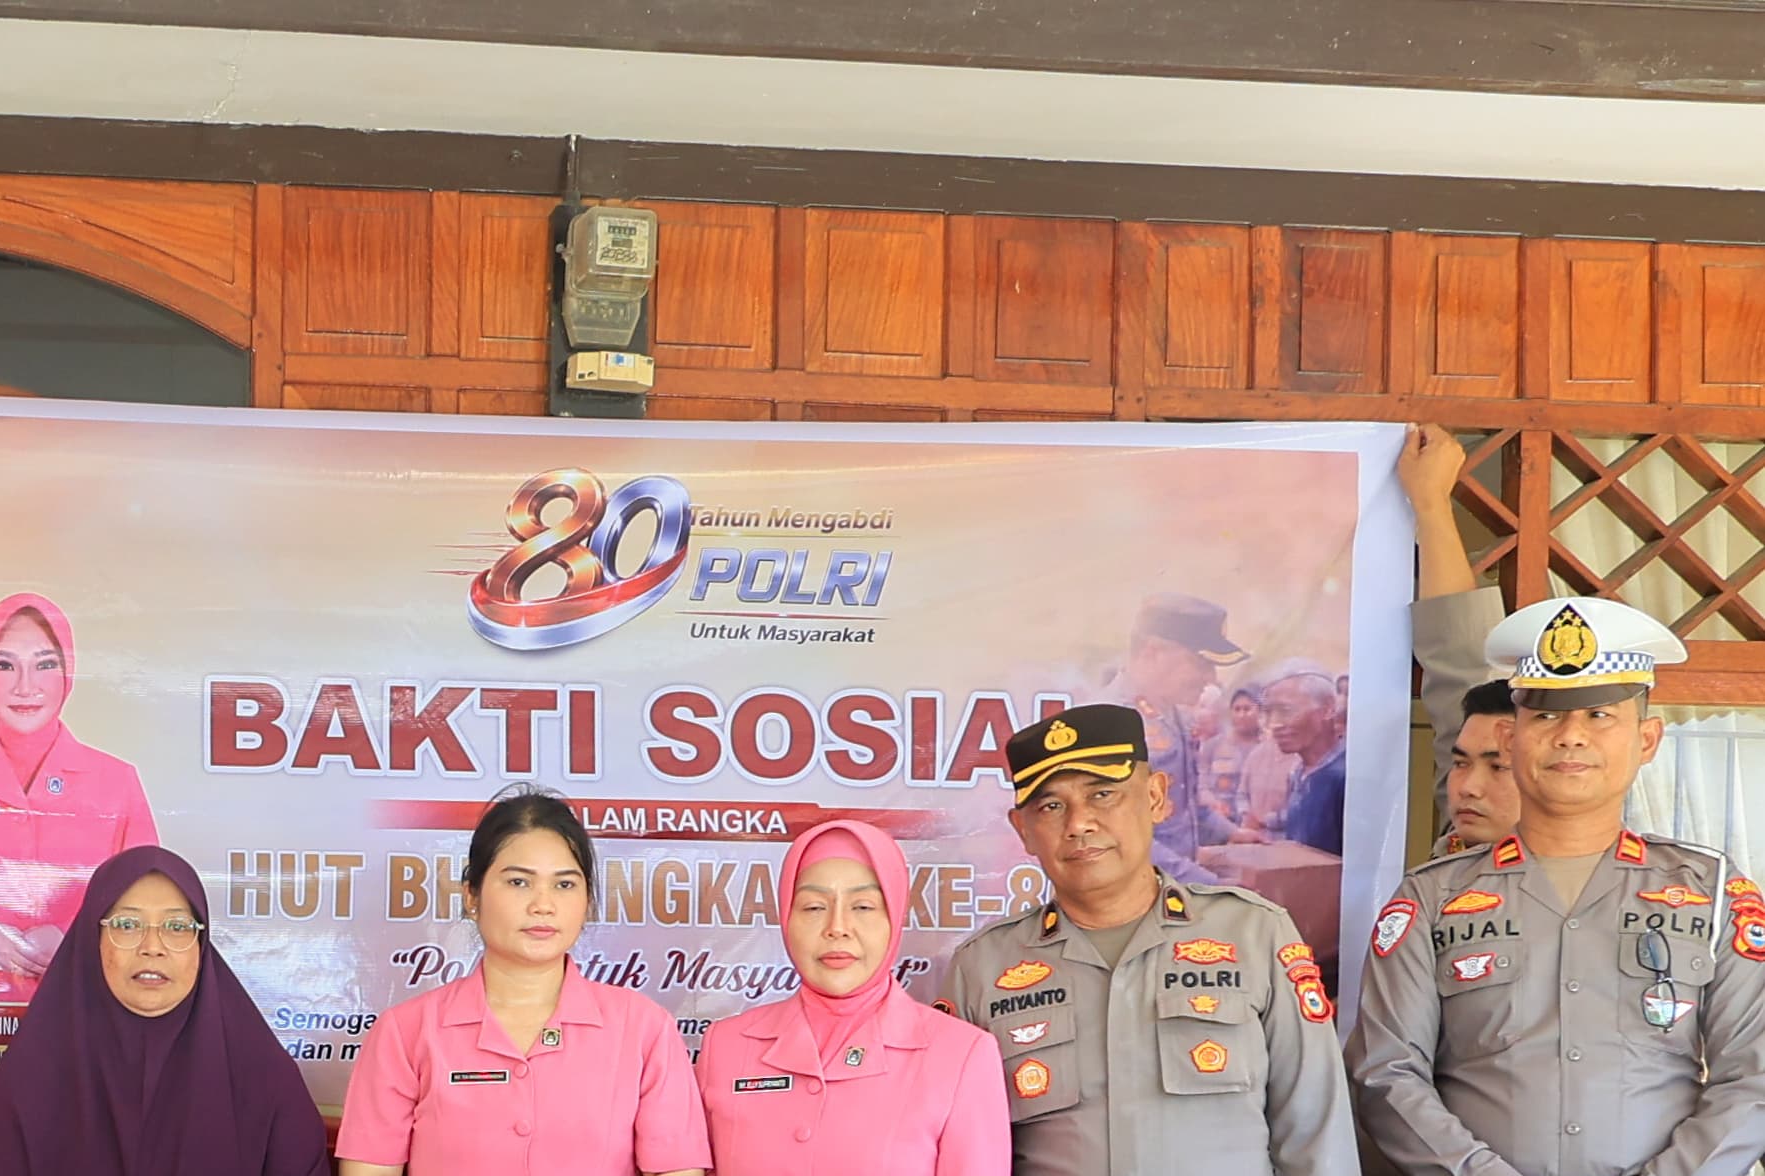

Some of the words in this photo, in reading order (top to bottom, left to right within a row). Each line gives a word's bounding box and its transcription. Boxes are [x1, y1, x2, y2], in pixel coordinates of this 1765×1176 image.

[690, 505, 759, 527] Tahun
[767, 506, 893, 533] Mengabdi
[478, 467, 691, 620] 80
[689, 547, 893, 607] POLRI
[690, 623, 752, 640] Untuk
[757, 625, 876, 645] Masyarakat
[206, 679, 599, 776] BAKTI
[646, 690, 1068, 784] SOSIA
[570, 806, 646, 831] LAM
[656, 807, 787, 834] RANGKA
[228, 851, 365, 919] HUT
[902, 864, 1053, 931] KE-8
[1432, 918, 1521, 950] RIJAL
[1623, 911, 1713, 942] POLRI
[1164, 970, 1241, 989] POLRI
[990, 987, 1067, 1018] PRIYANTO
[275, 1007, 377, 1035] Semoga
[286, 1039, 332, 1059] dan
